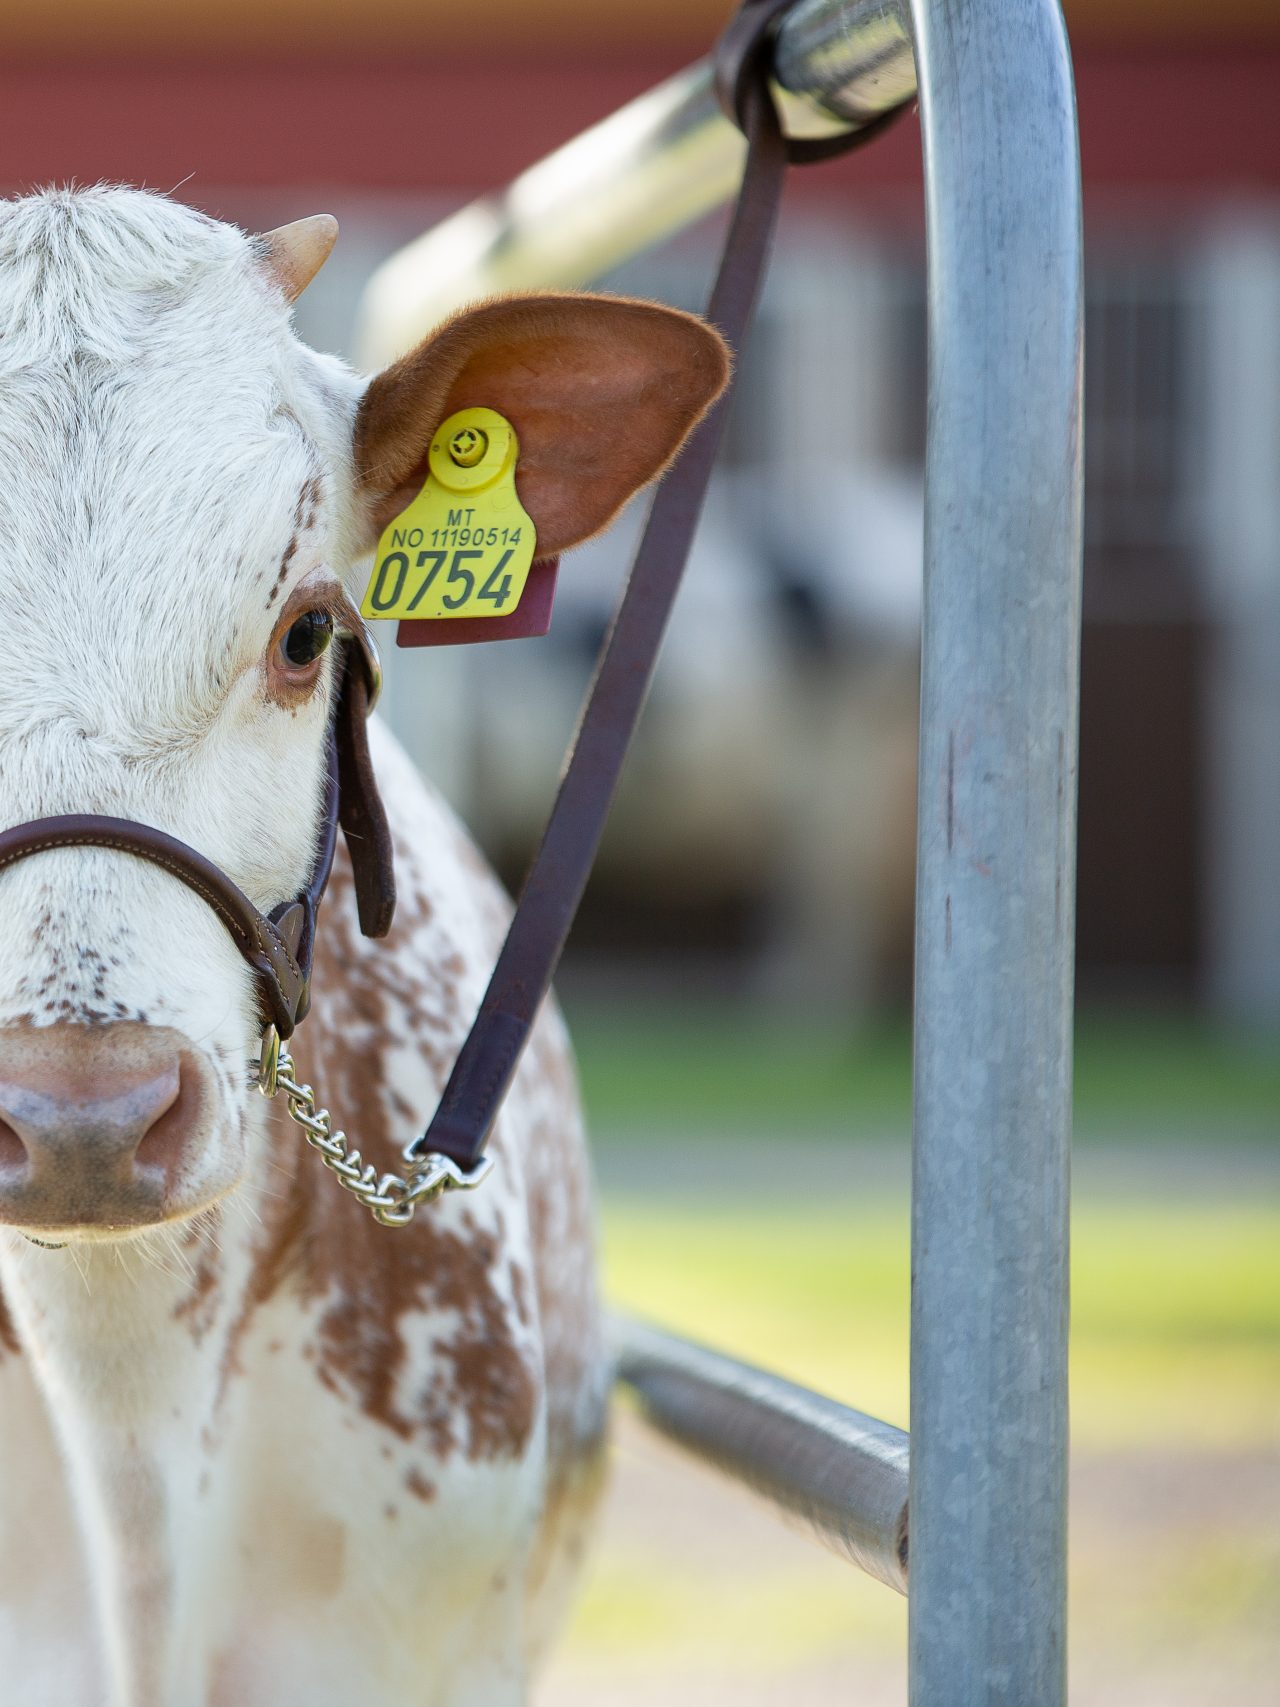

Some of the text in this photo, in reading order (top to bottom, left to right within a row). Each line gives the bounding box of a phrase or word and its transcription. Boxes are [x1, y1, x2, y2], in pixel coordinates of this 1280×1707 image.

[447, 508, 476, 526] MT
[390, 527, 522, 548] NO 11190514
[370, 549, 516, 611] 0754
